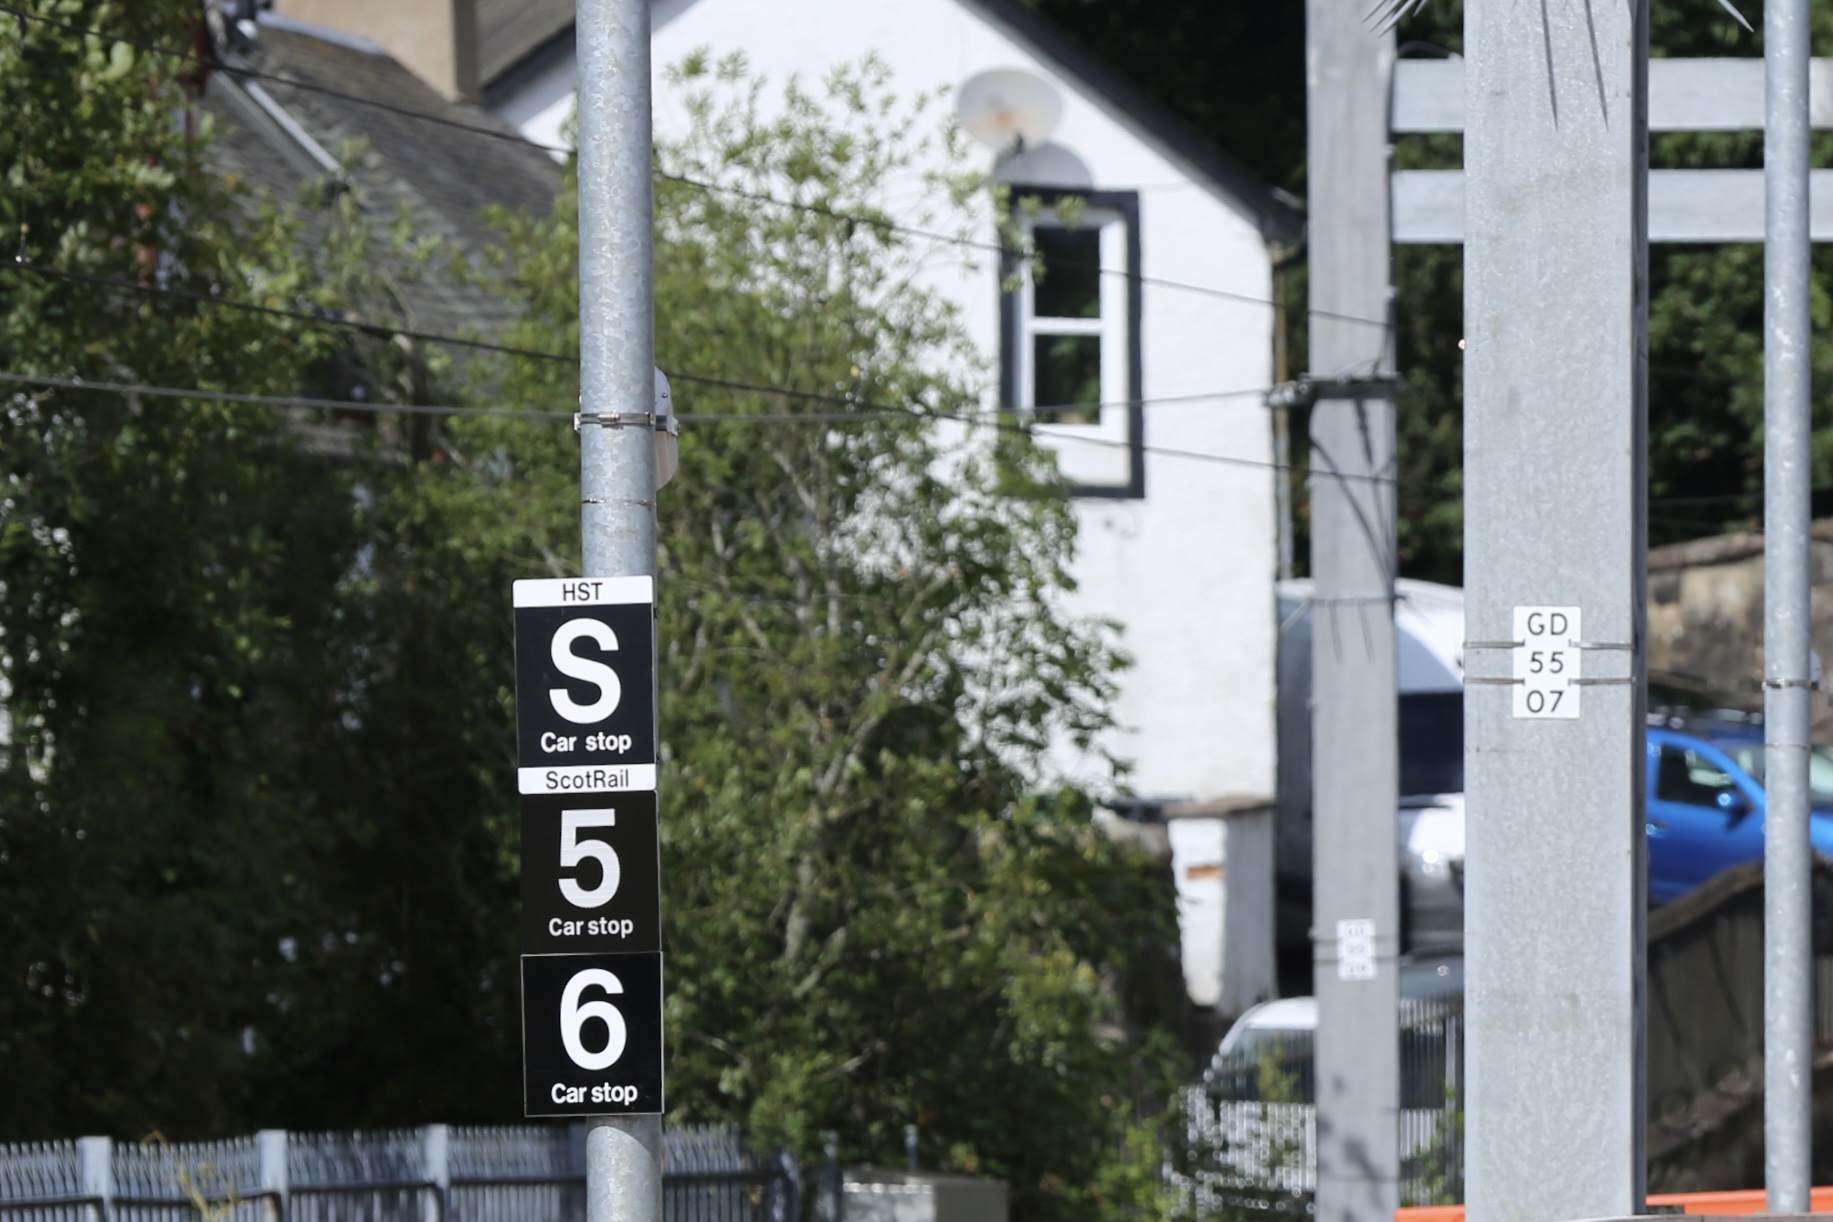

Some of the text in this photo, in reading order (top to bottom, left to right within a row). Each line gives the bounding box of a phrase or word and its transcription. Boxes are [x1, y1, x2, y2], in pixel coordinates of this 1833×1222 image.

[562, 582, 603, 601] HST
[1527, 611, 1568, 636] GD
[549, 617, 622, 725] S
[1529, 651, 1564, 674] 55
[1526, 689, 1565, 714] 07
[540, 731, 633, 754] Car stop
[545, 769, 630, 790] ScotRail
[558, 808, 621, 909] 5
[548, 916, 634, 939] Car stop
[560, 967, 627, 1071] 6
[551, 1081, 639, 1106] Car stop
